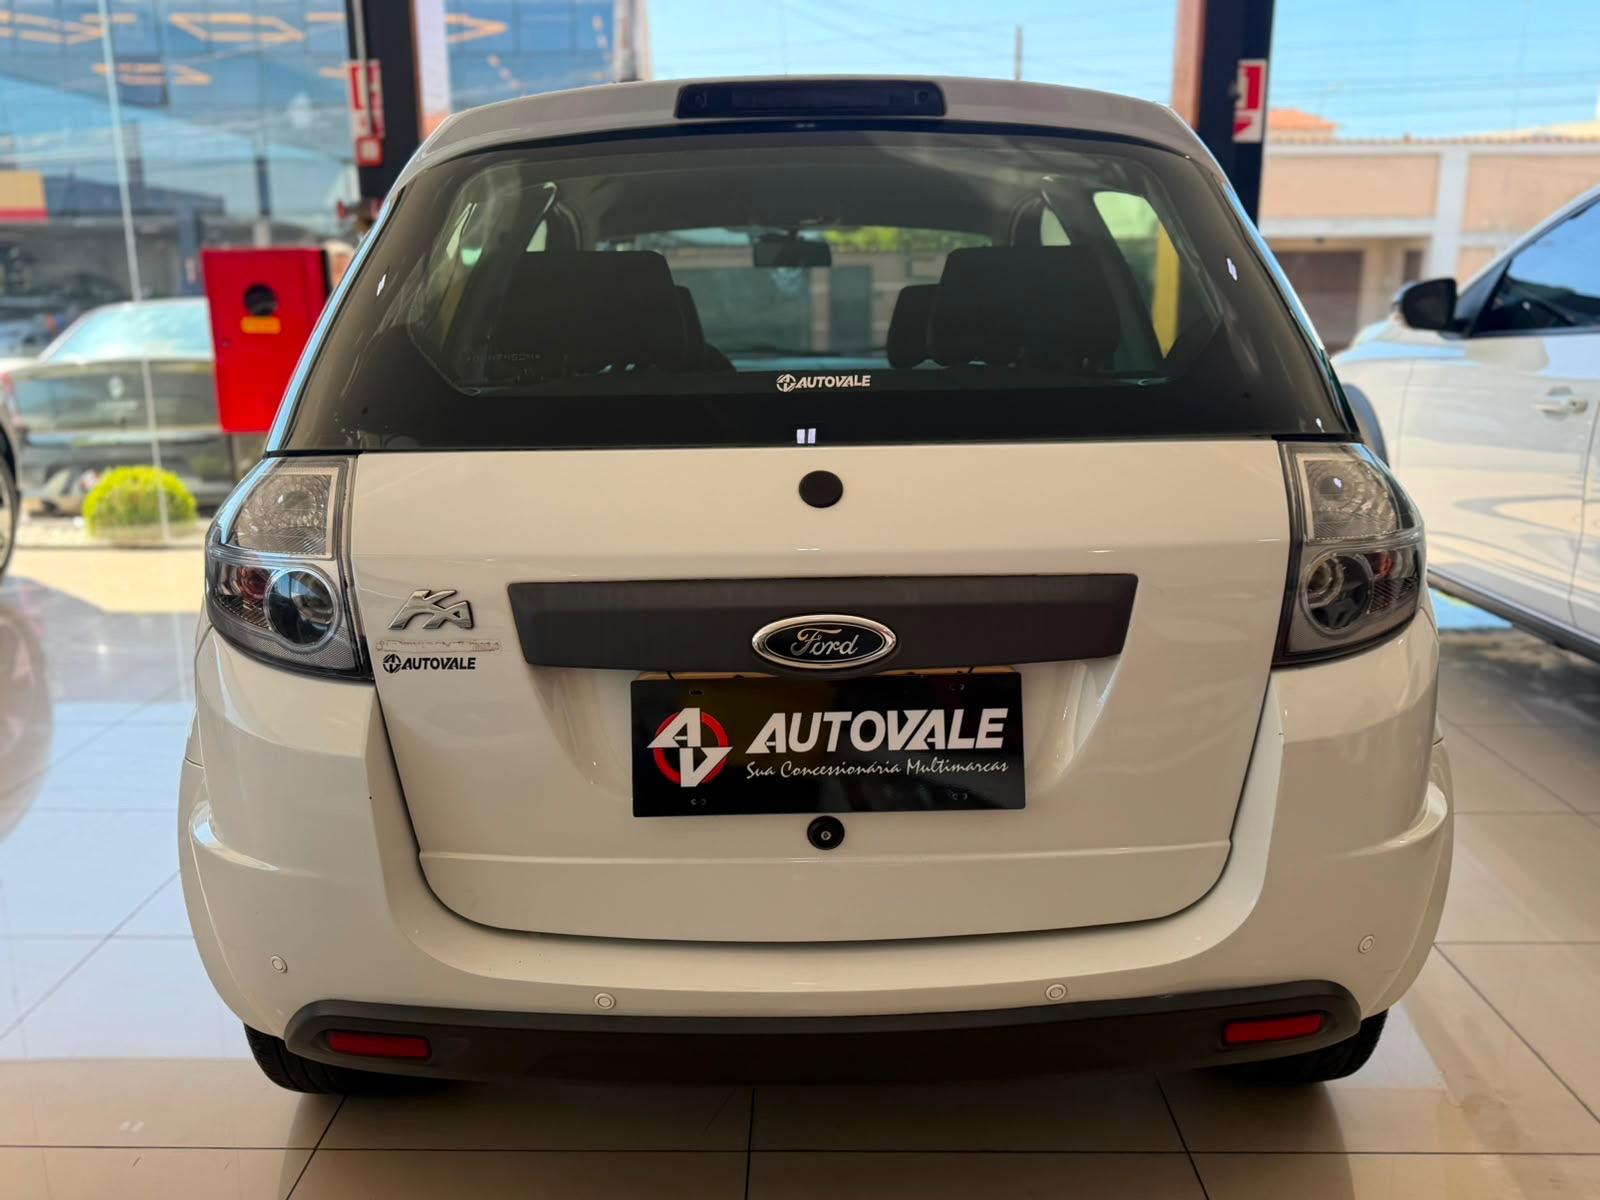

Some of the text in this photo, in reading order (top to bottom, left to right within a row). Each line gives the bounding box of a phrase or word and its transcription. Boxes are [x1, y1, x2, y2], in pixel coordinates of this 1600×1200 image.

[796, 374, 871, 389] AUTOVALE
[790, 627, 858, 656] Ford
[401, 657, 476, 671] AUTOVALE
[745, 707, 1008, 754] AUTOVALE
[746, 758, 1009, 780] Sua Concessionária Multimarcas
